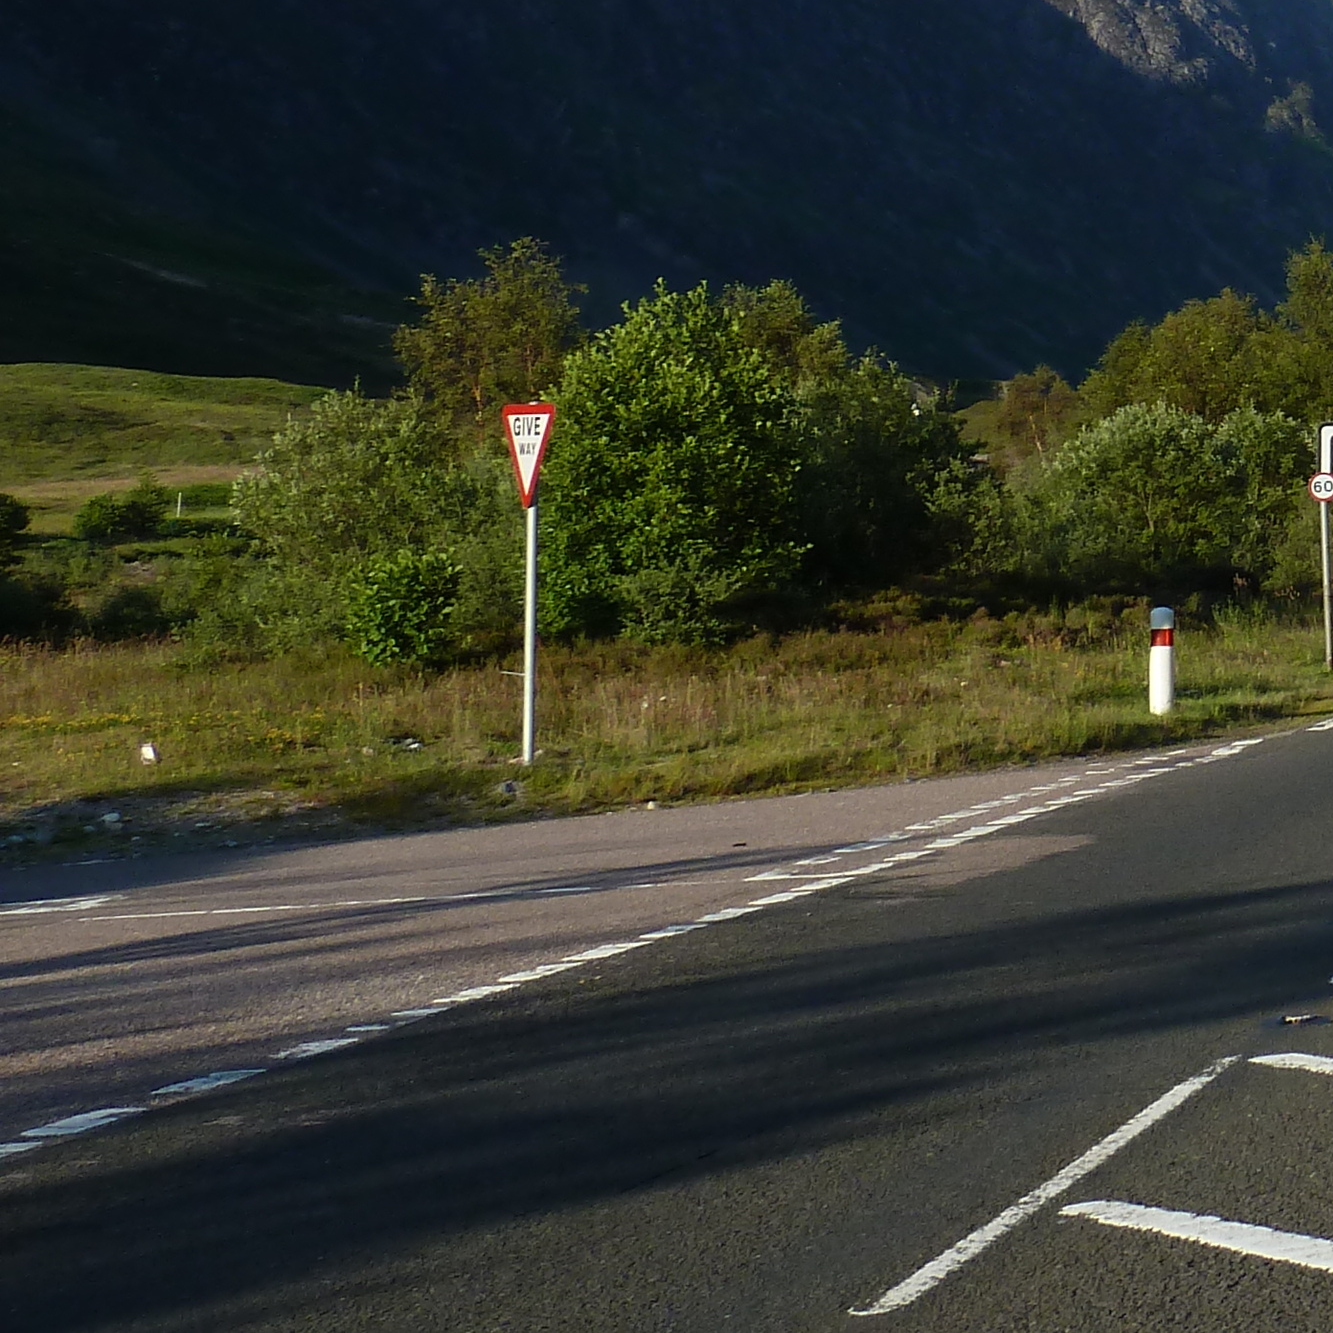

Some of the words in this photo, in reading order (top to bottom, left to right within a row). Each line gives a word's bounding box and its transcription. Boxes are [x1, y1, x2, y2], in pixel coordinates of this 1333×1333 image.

[513, 417, 541, 436] GIVE
[519, 442, 537, 455] WAY
[1313, 480, 1333, 493] 60
